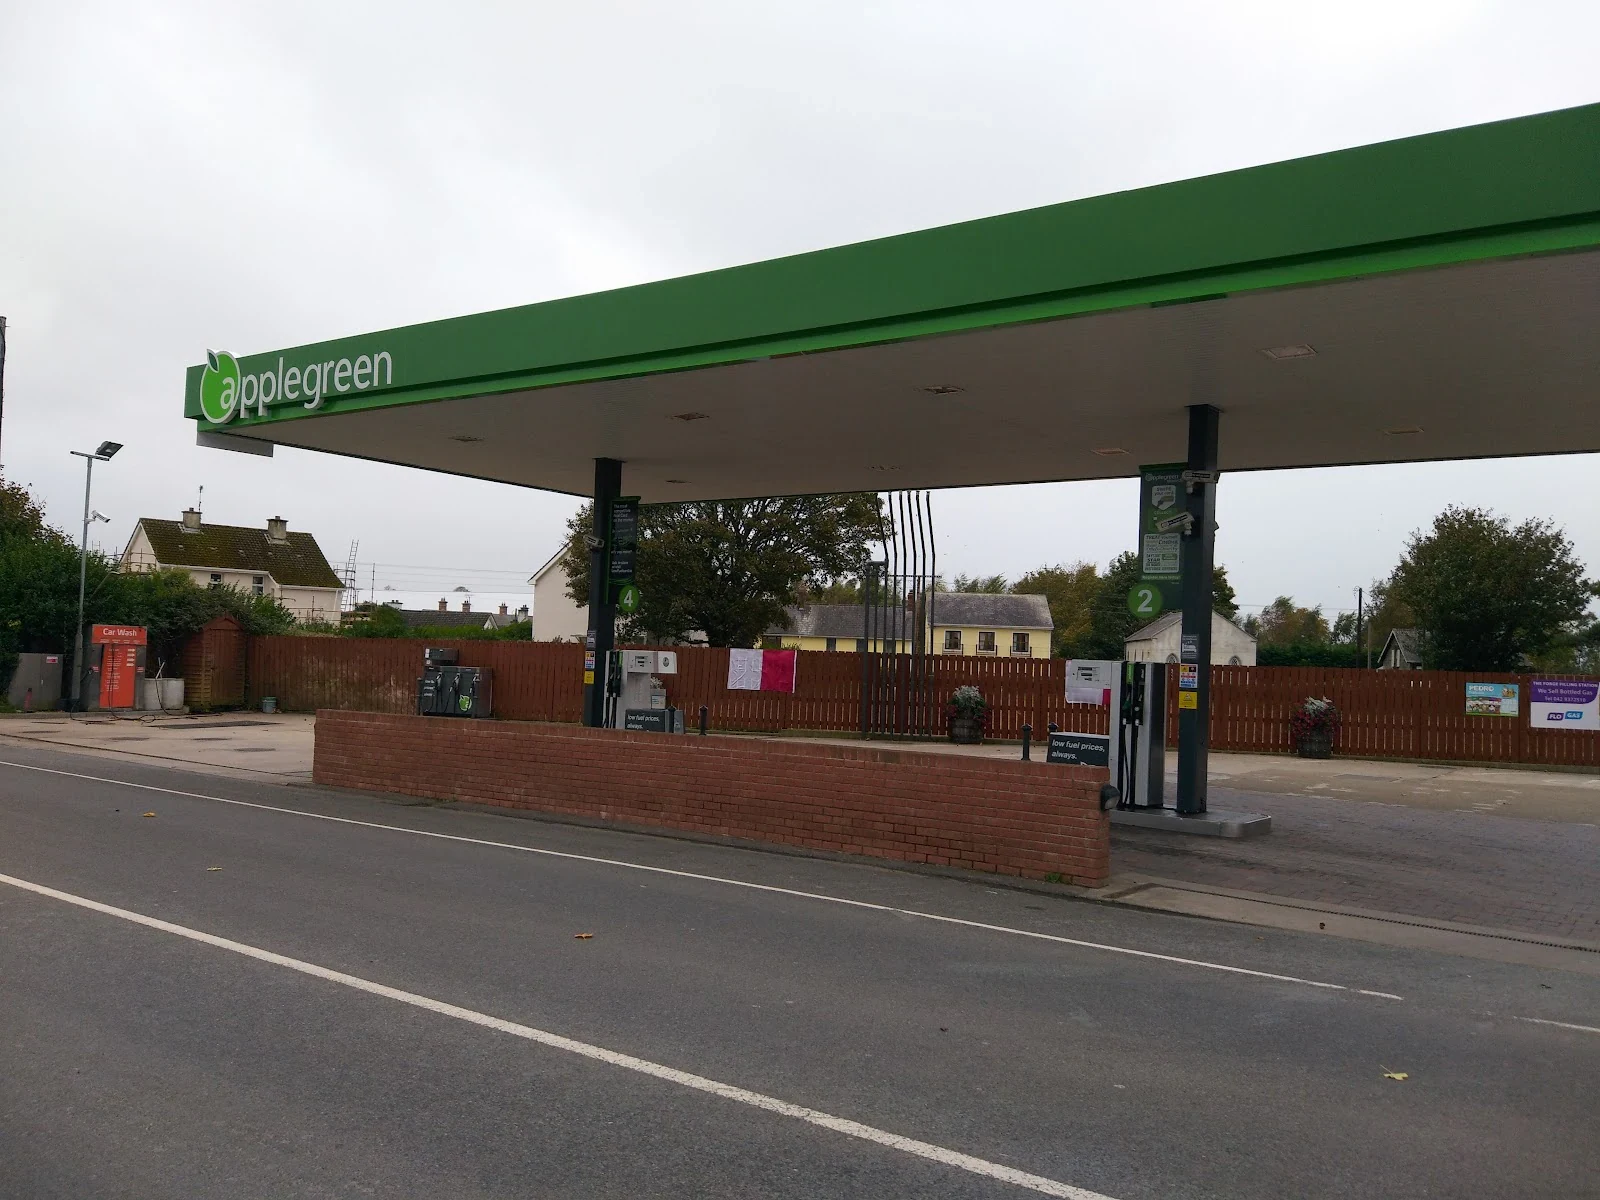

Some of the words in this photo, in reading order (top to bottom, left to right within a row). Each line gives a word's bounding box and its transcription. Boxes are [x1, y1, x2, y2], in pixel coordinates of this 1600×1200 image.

[219, 350, 393, 419] applegreen
[623, 589, 634, 607] 4
[1137, 589, 1153, 612] 2
[102, 628, 115, 636] Car
[117, 628, 137, 637] Wash
[1051, 739, 1065, 747] low
[1065, 740, 1080, 749] fuel
[1080, 743, 1105, 752] prices,
[1051, 750, 1078, 760] always.
